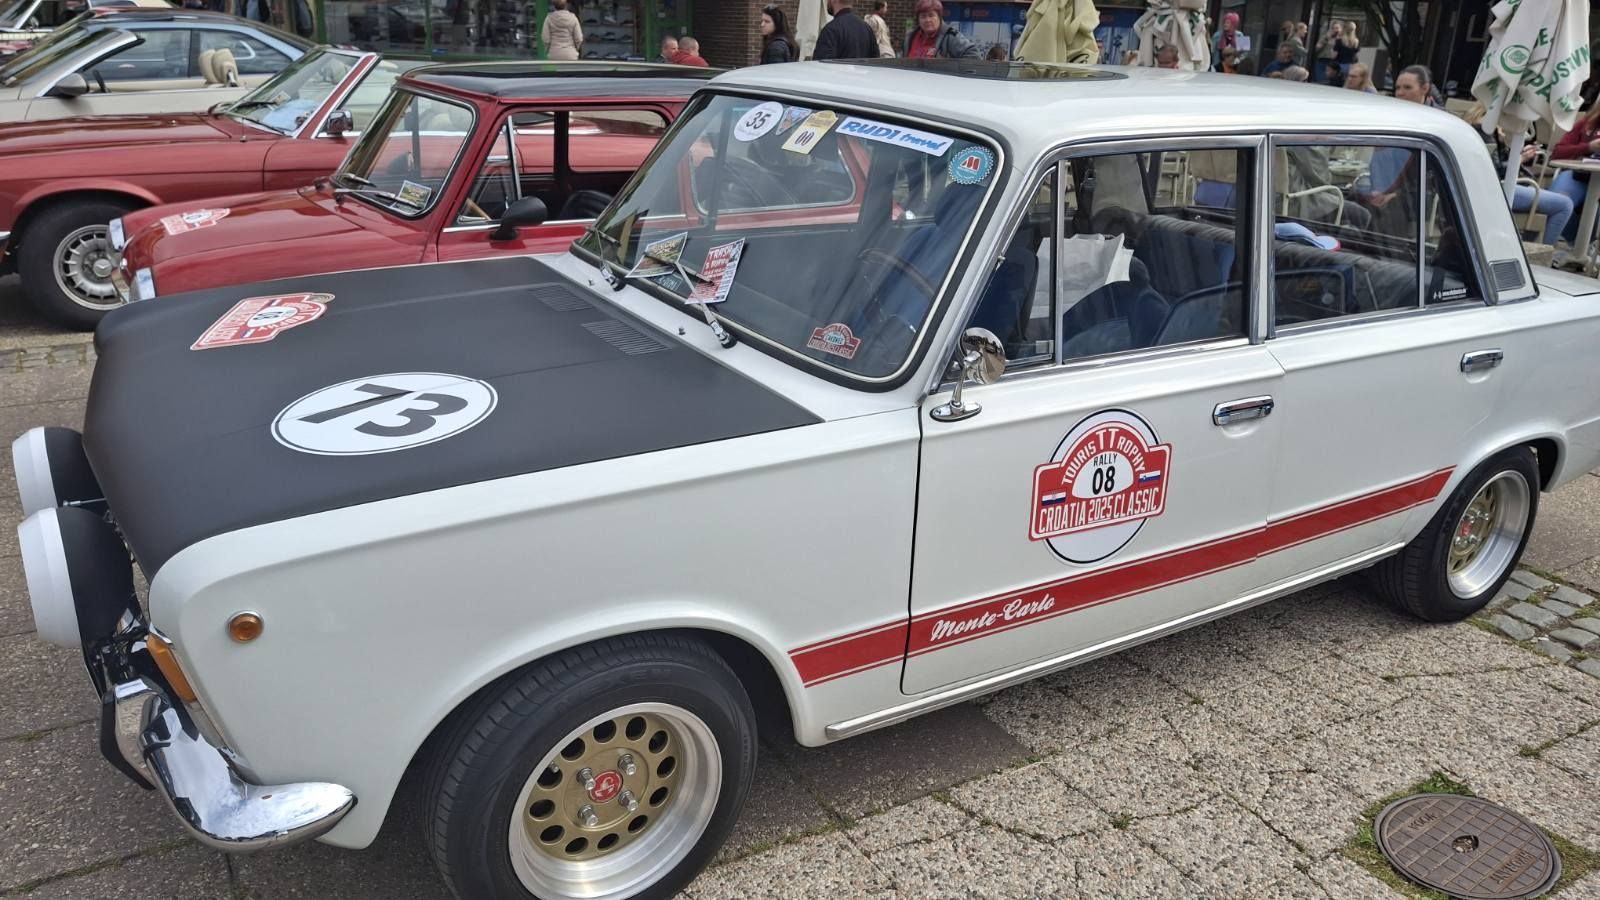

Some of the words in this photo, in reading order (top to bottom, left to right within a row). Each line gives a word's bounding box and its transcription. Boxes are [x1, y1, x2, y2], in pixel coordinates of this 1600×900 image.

[745, 111, 772, 130] 35
[841, 121, 901, 140] RUDI
[296, 383, 469, 437] 73
[1093, 453, 1118, 467] RALLY
[1092, 465, 1116, 496] 08
[1038, 501, 1086, 534] CROATIA
[1088, 496, 1113, 523] 2025
[1113, 487, 1159, 519] CLASSIC
[930, 593, 1056, 641] Monte-Carlo
